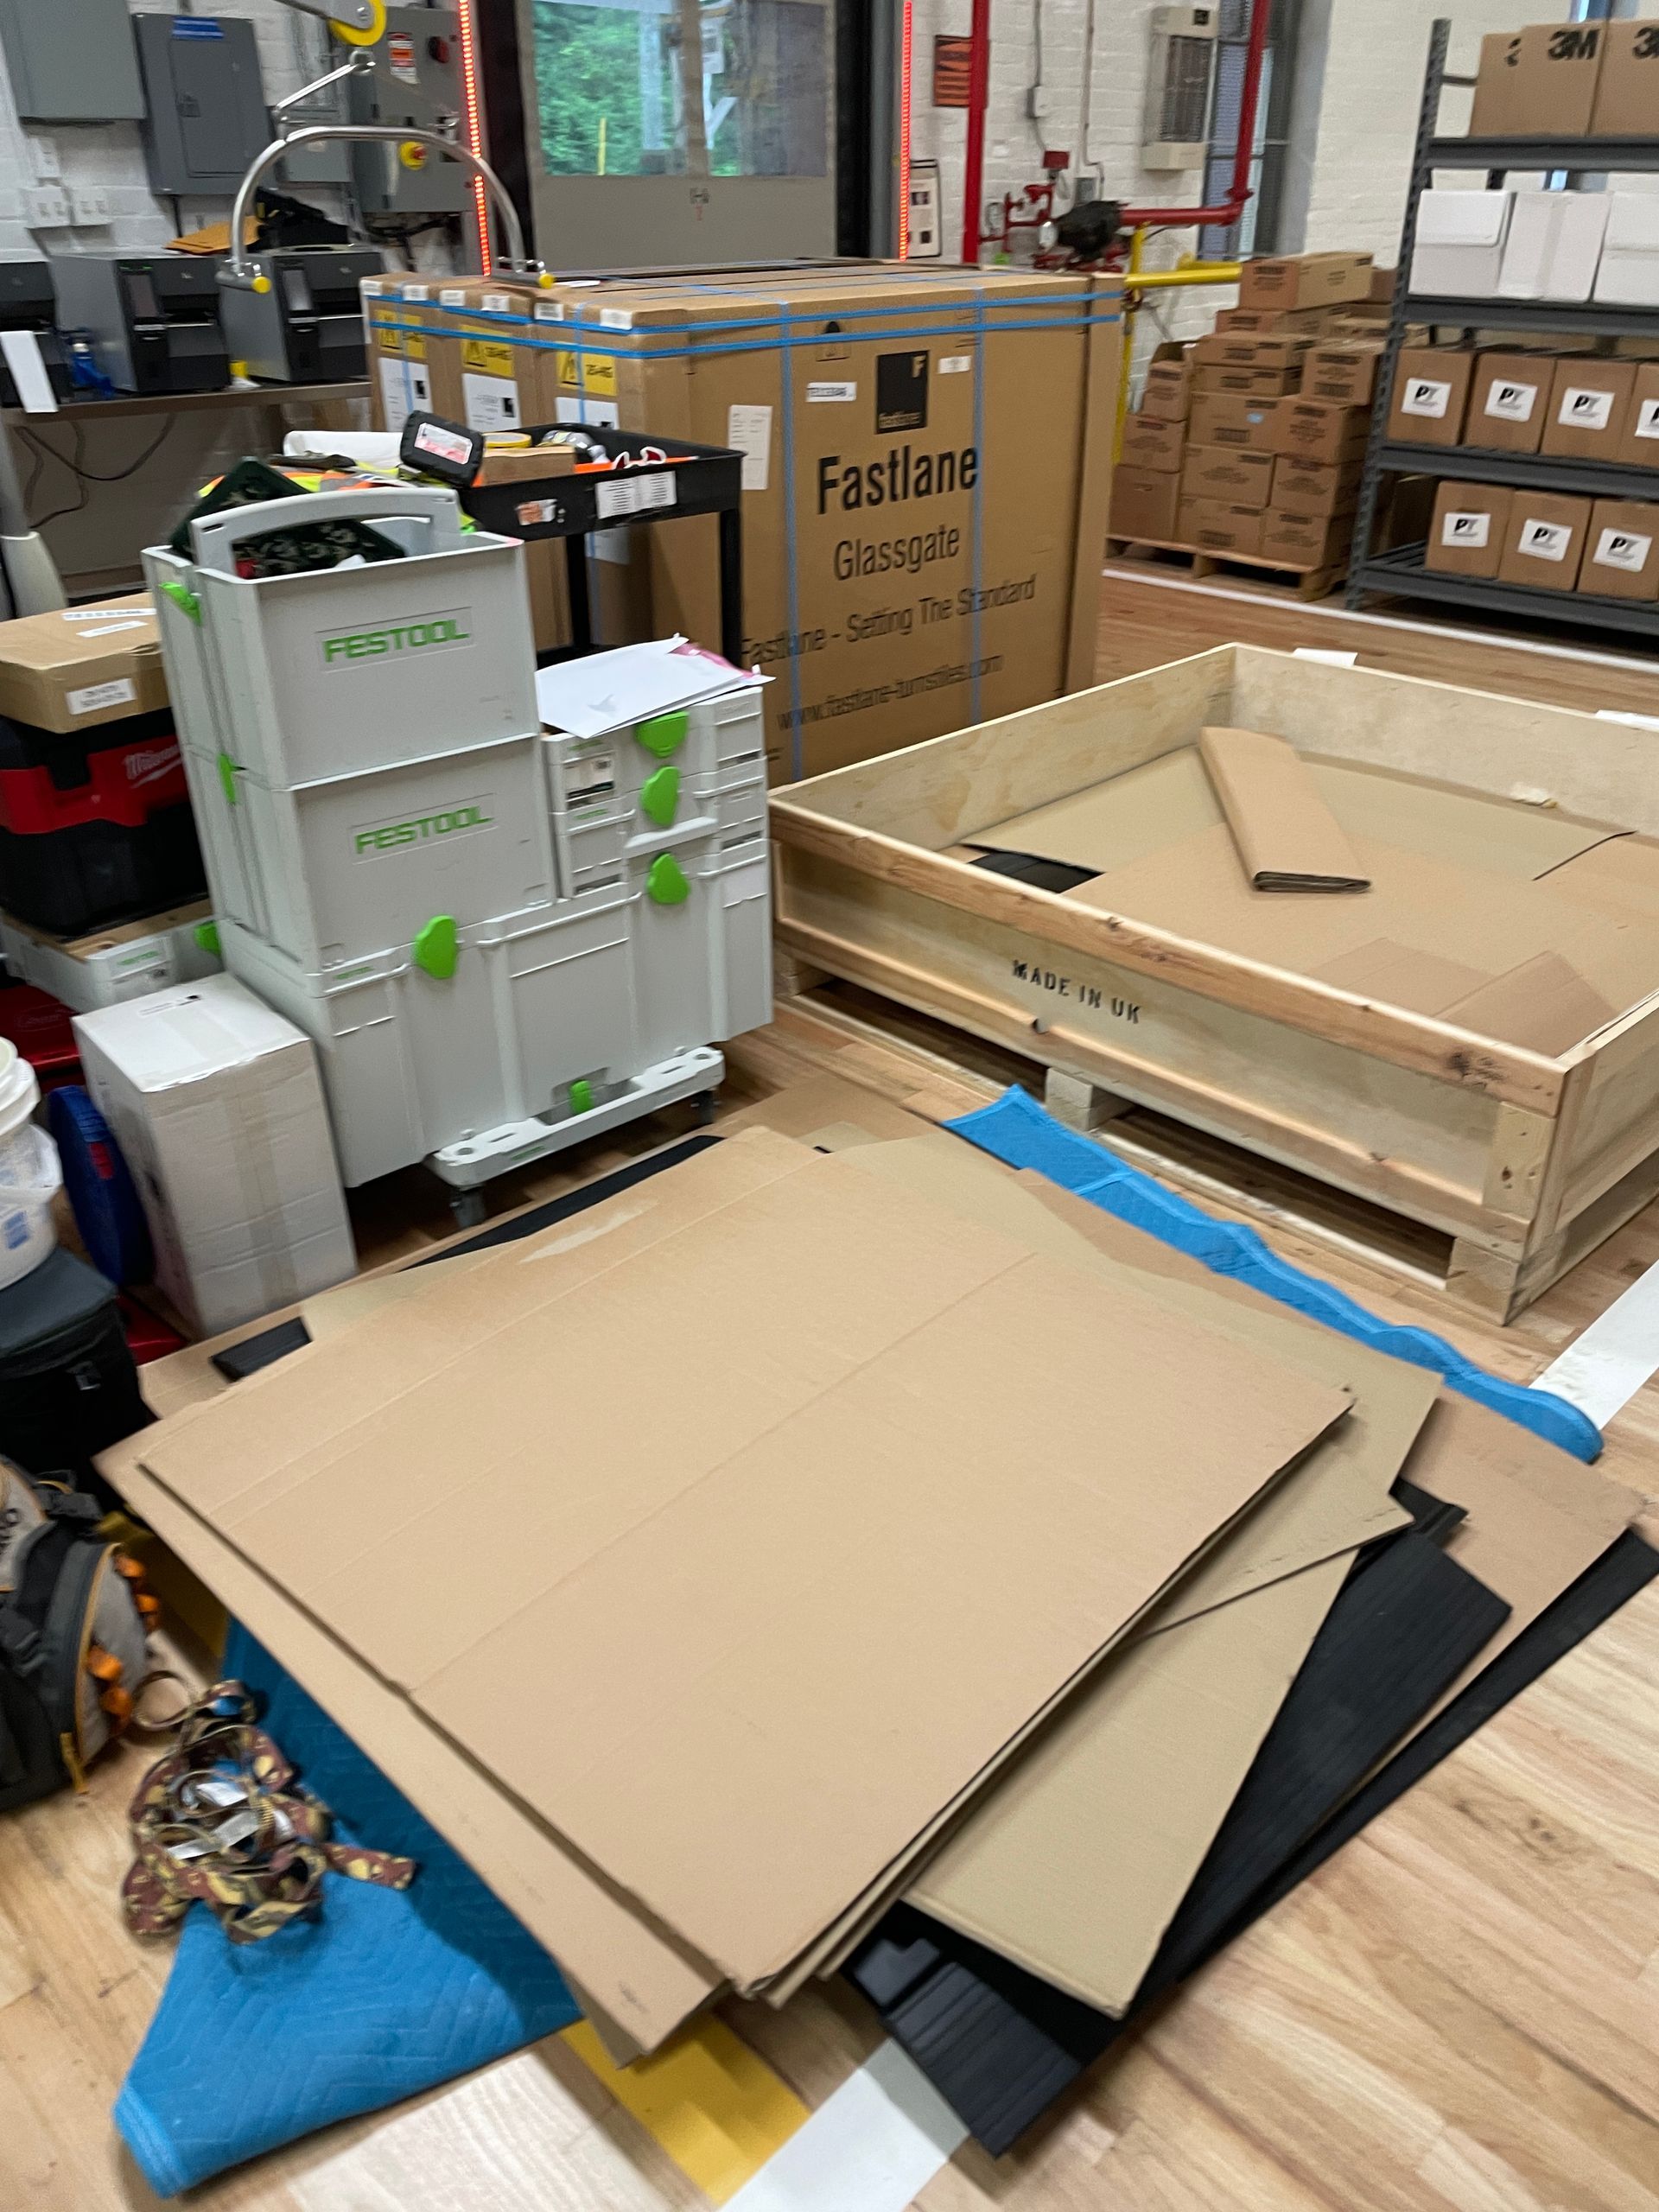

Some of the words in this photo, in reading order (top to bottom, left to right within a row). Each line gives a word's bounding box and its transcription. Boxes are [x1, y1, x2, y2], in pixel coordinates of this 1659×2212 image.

[1548, 29, 1600, 60] 3M
[1632, 27, 1659, 60] 3
[817, 444, 979, 515] Fastlane
[833, 524, 960, 581] Glassgate
[918, 596, 951, 624] The
[956, 573, 1037, 615] Standard
[322, 619, 471, 663] FESTOOL
[354, 805, 495, 855] FESTOOL
[1012, 959, 1071, 996] MADE
[1078, 985, 1103, 1008] IN
[1111, 997, 1141, 1024] UK
